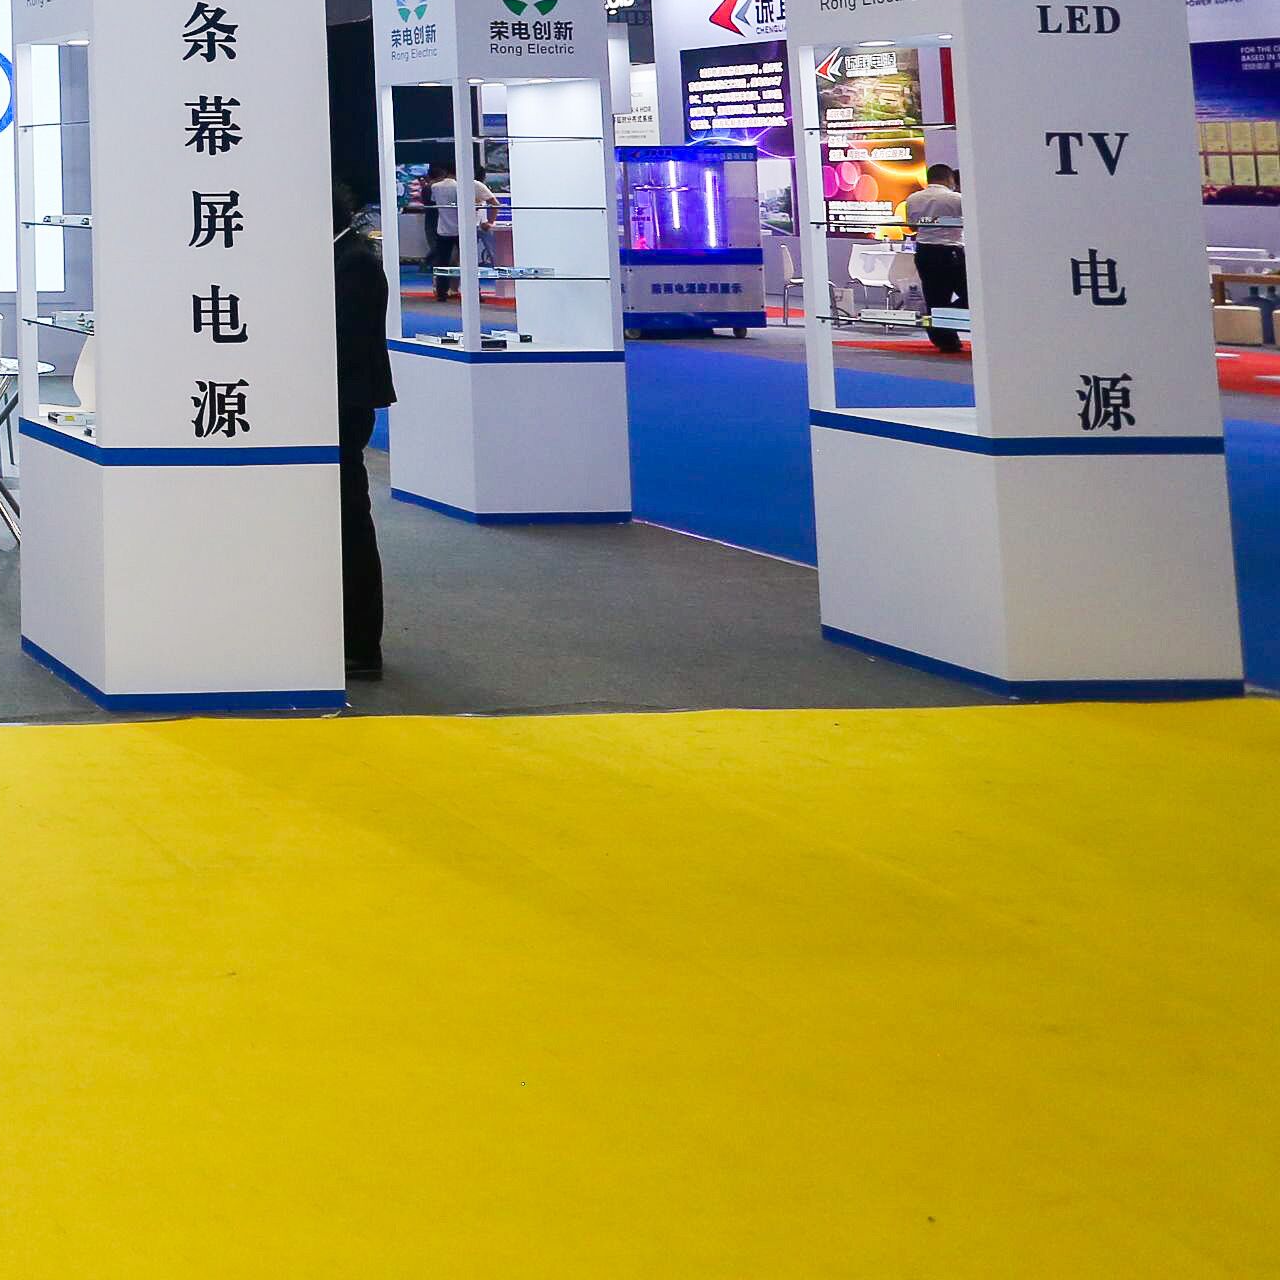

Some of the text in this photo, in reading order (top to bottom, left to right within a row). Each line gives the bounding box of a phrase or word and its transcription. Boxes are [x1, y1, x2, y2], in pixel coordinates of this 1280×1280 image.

[490, 21, 573, 41] 荣电创新
[1036, 5, 1120, 34] LED
[391, 24, 436, 48] 荣电创新
[490, 43, 574, 56] Rong Electric
[1045, 132, 1129, 176] TV
